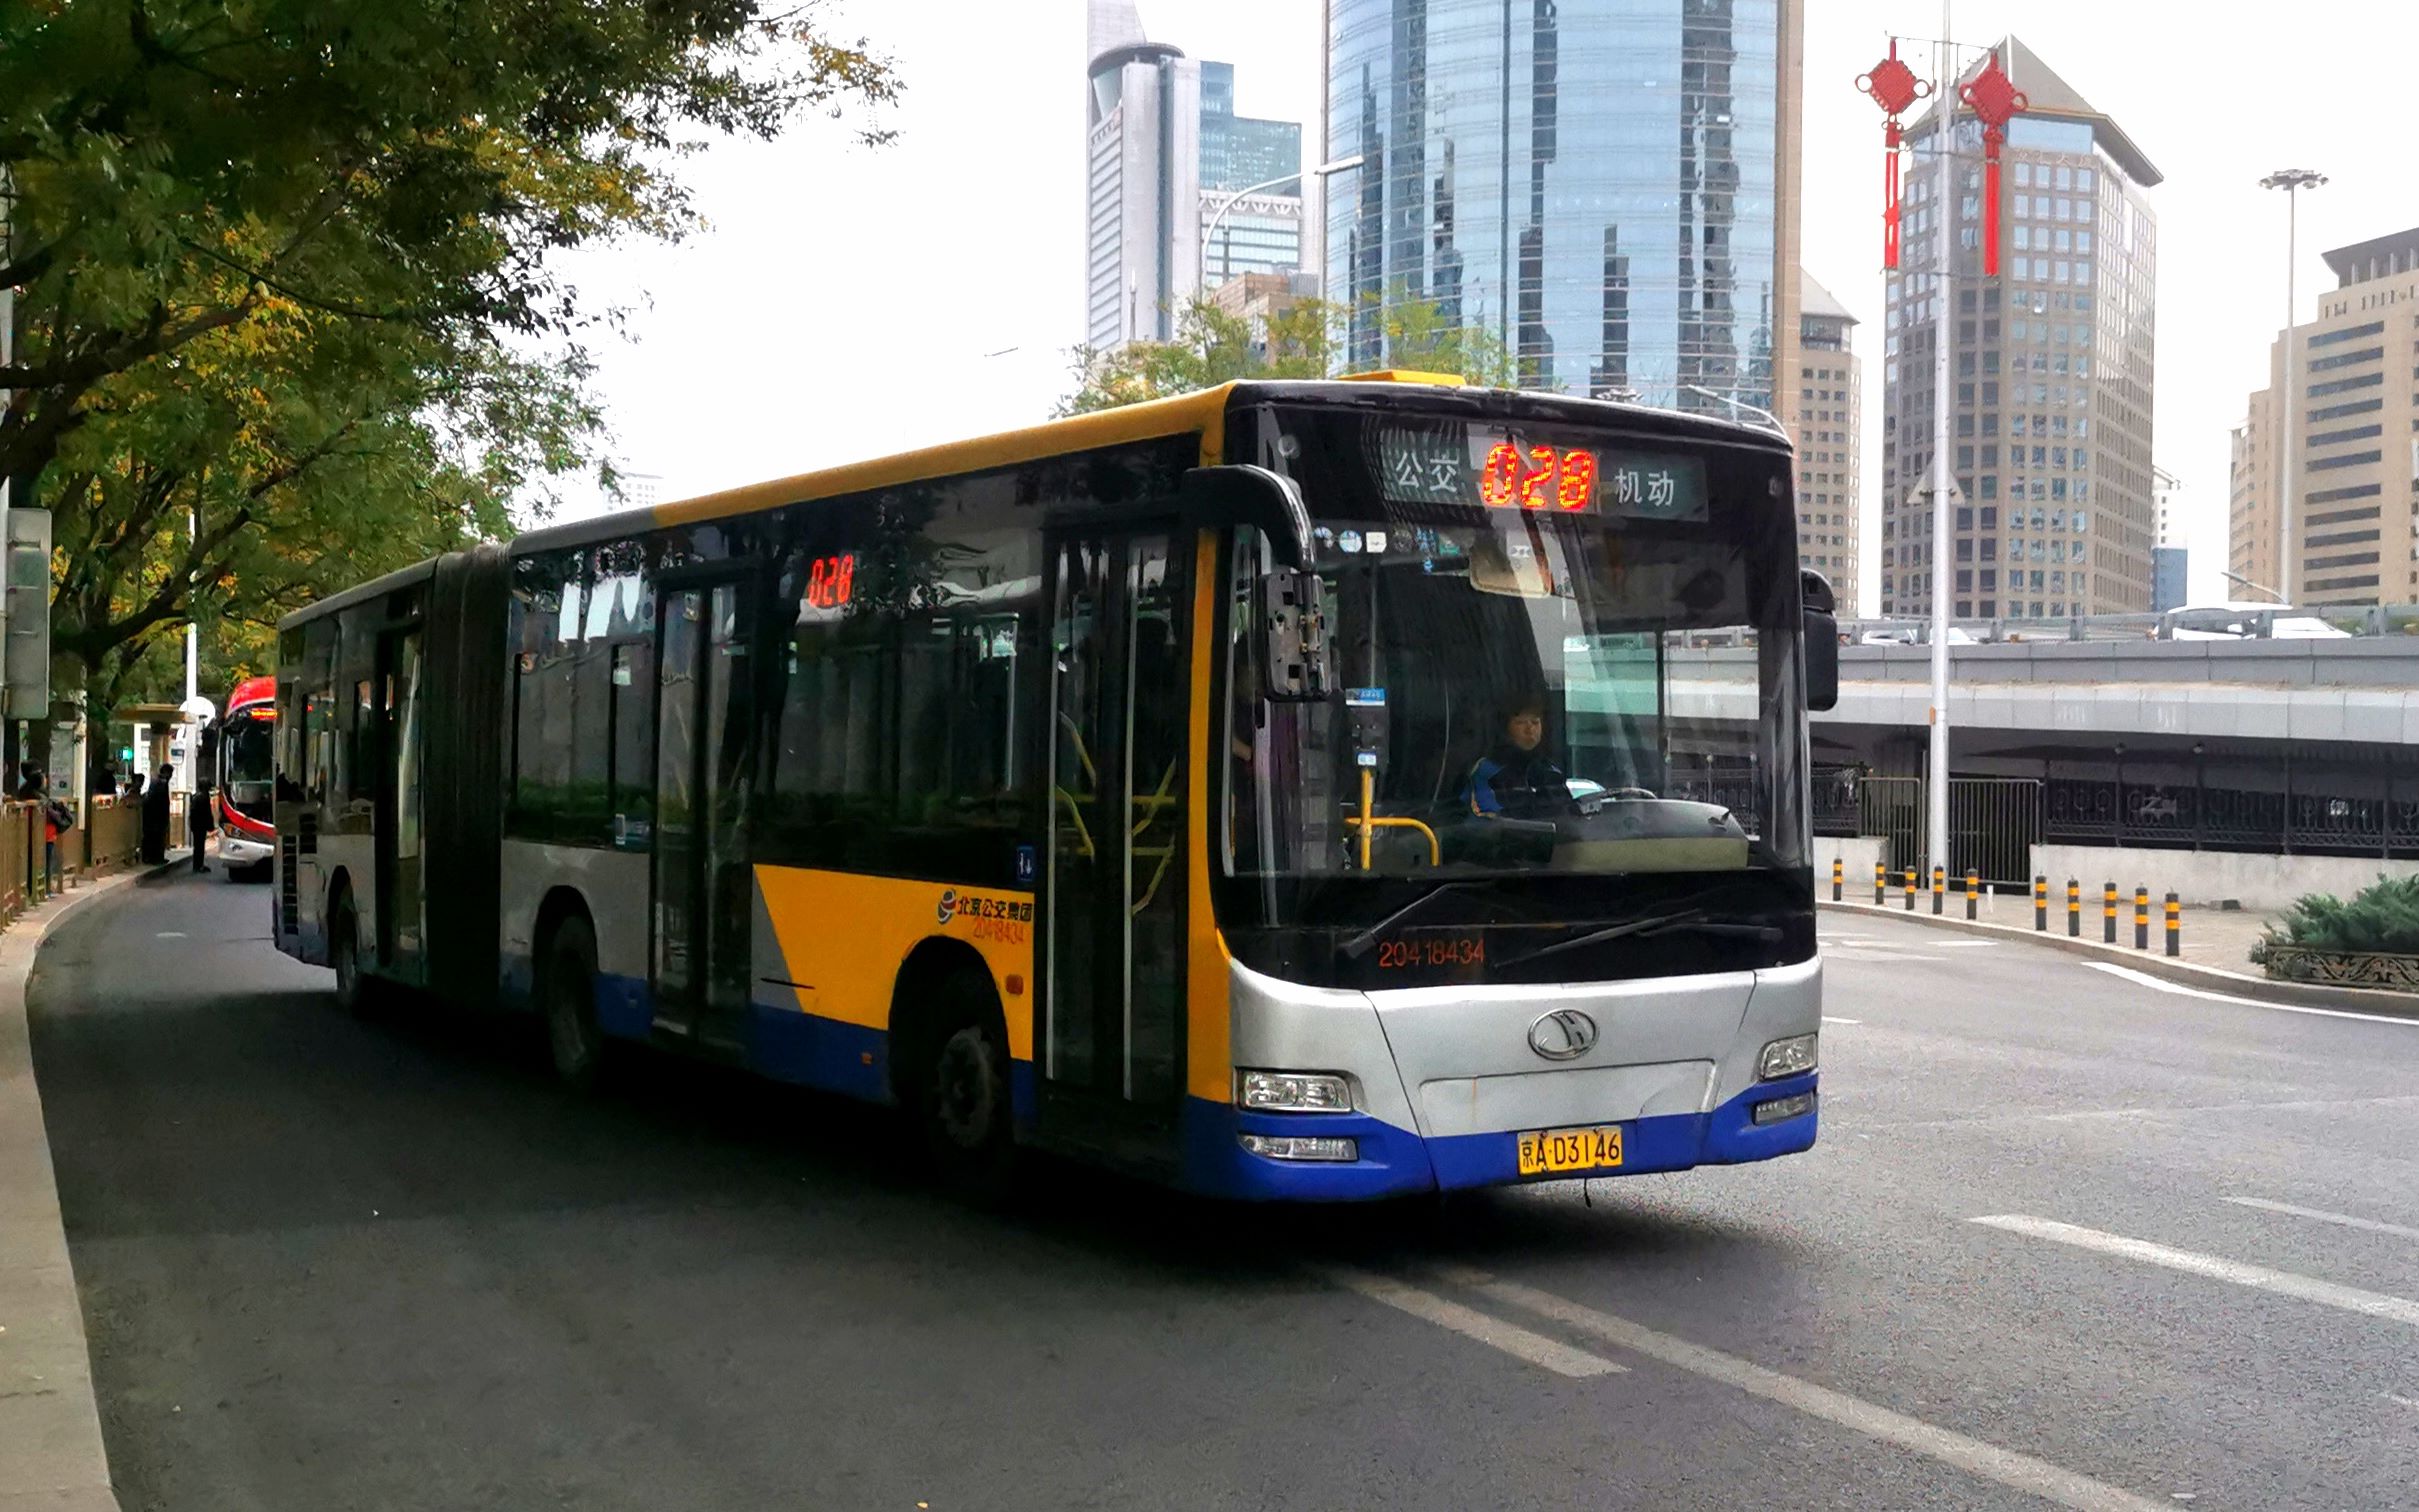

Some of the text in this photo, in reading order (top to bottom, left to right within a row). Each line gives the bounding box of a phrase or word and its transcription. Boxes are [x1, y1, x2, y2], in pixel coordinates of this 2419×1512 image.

[1395, 443, 1675, 512] 公交 028 机动
[808, 553, 853, 607] 028
[957, 896, 1032, 921] 北京公交集团
[1378, 937, 1485, 968] 20418434
